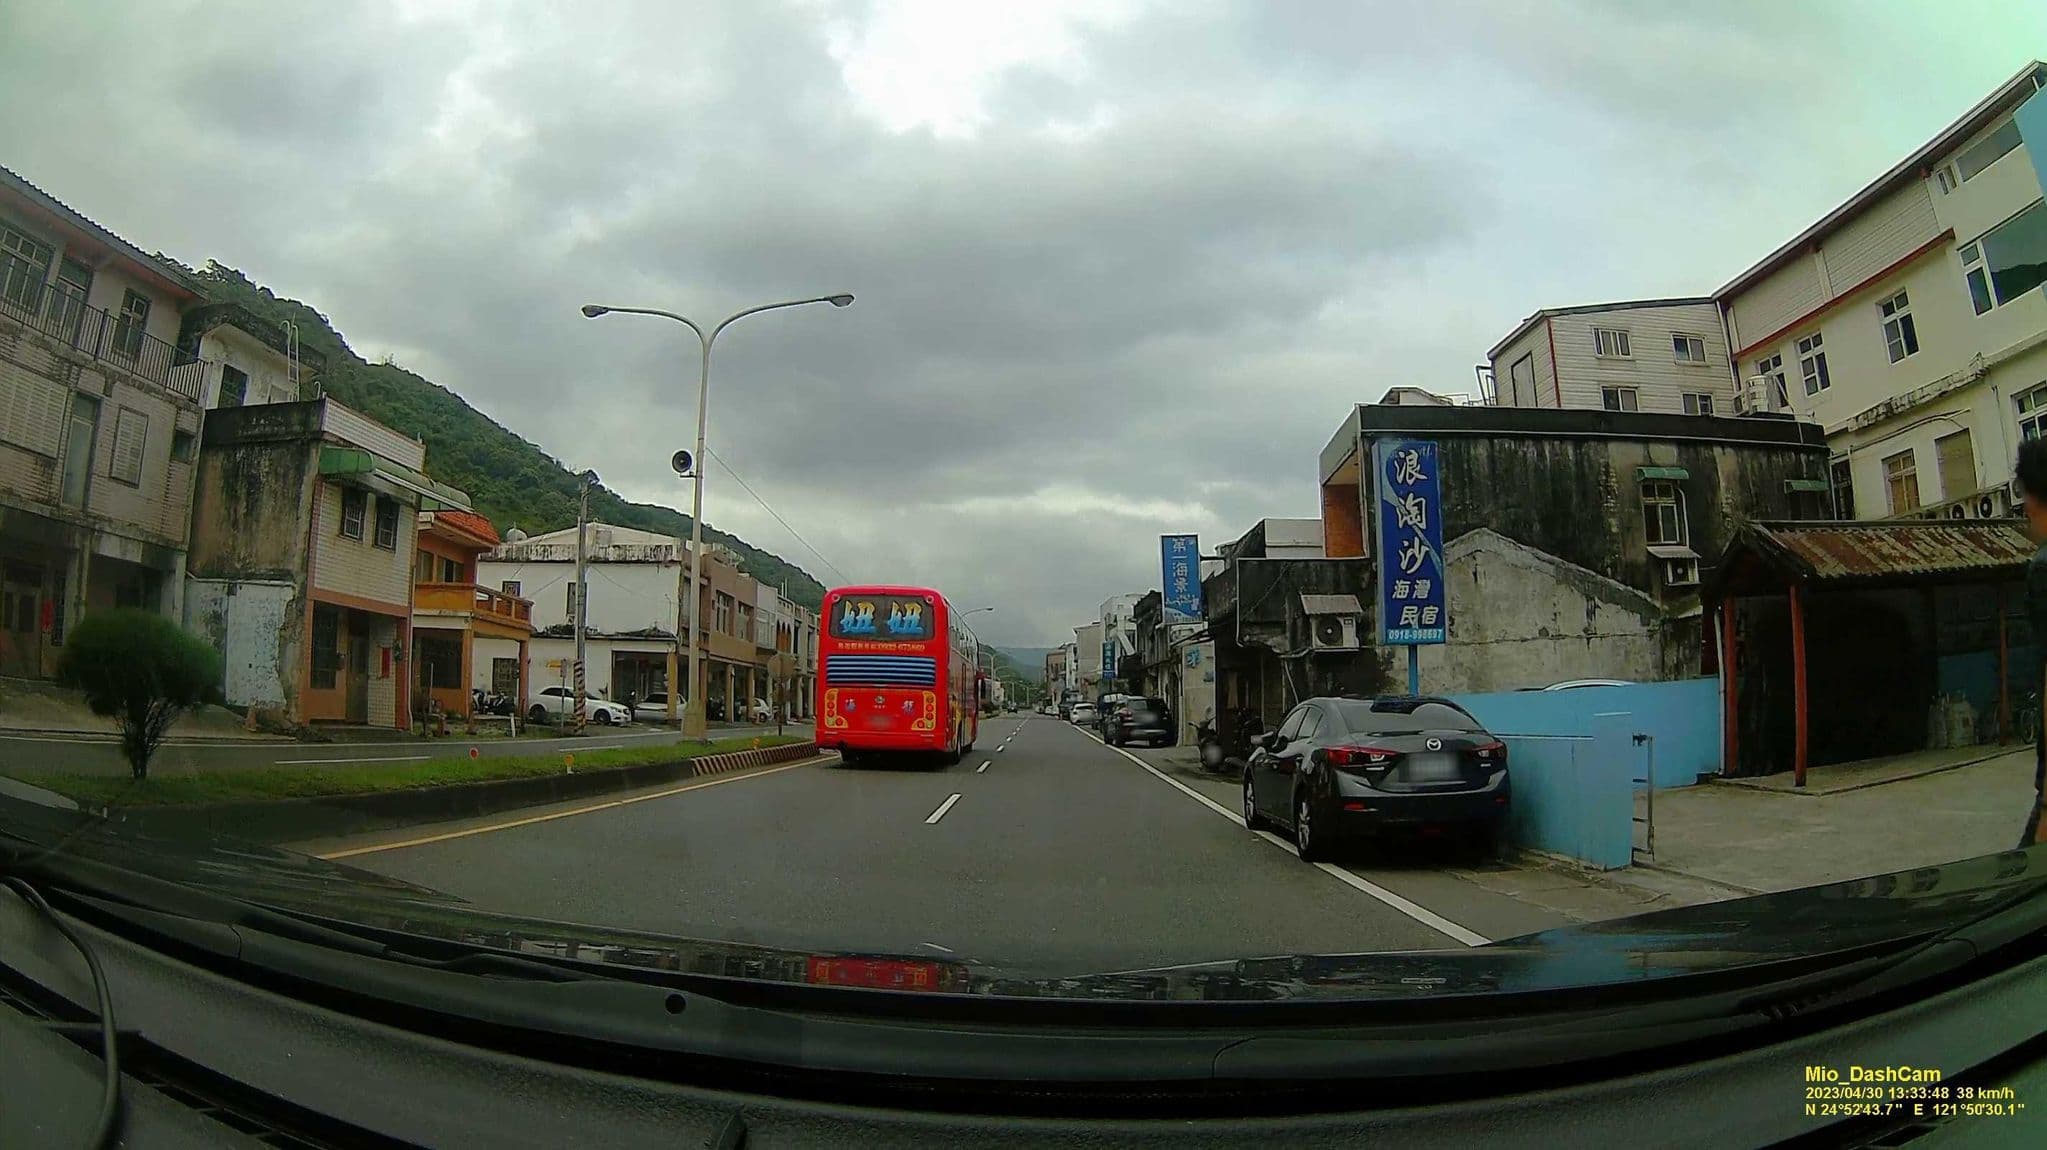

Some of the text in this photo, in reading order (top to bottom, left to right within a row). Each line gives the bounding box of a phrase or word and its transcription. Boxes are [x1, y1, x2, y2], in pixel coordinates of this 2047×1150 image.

[1394, 449, 1430, 574] 浪淘沙
[1392, 579, 1431, 599] 海灣
[1400, 605, 1439, 626] 民宿
